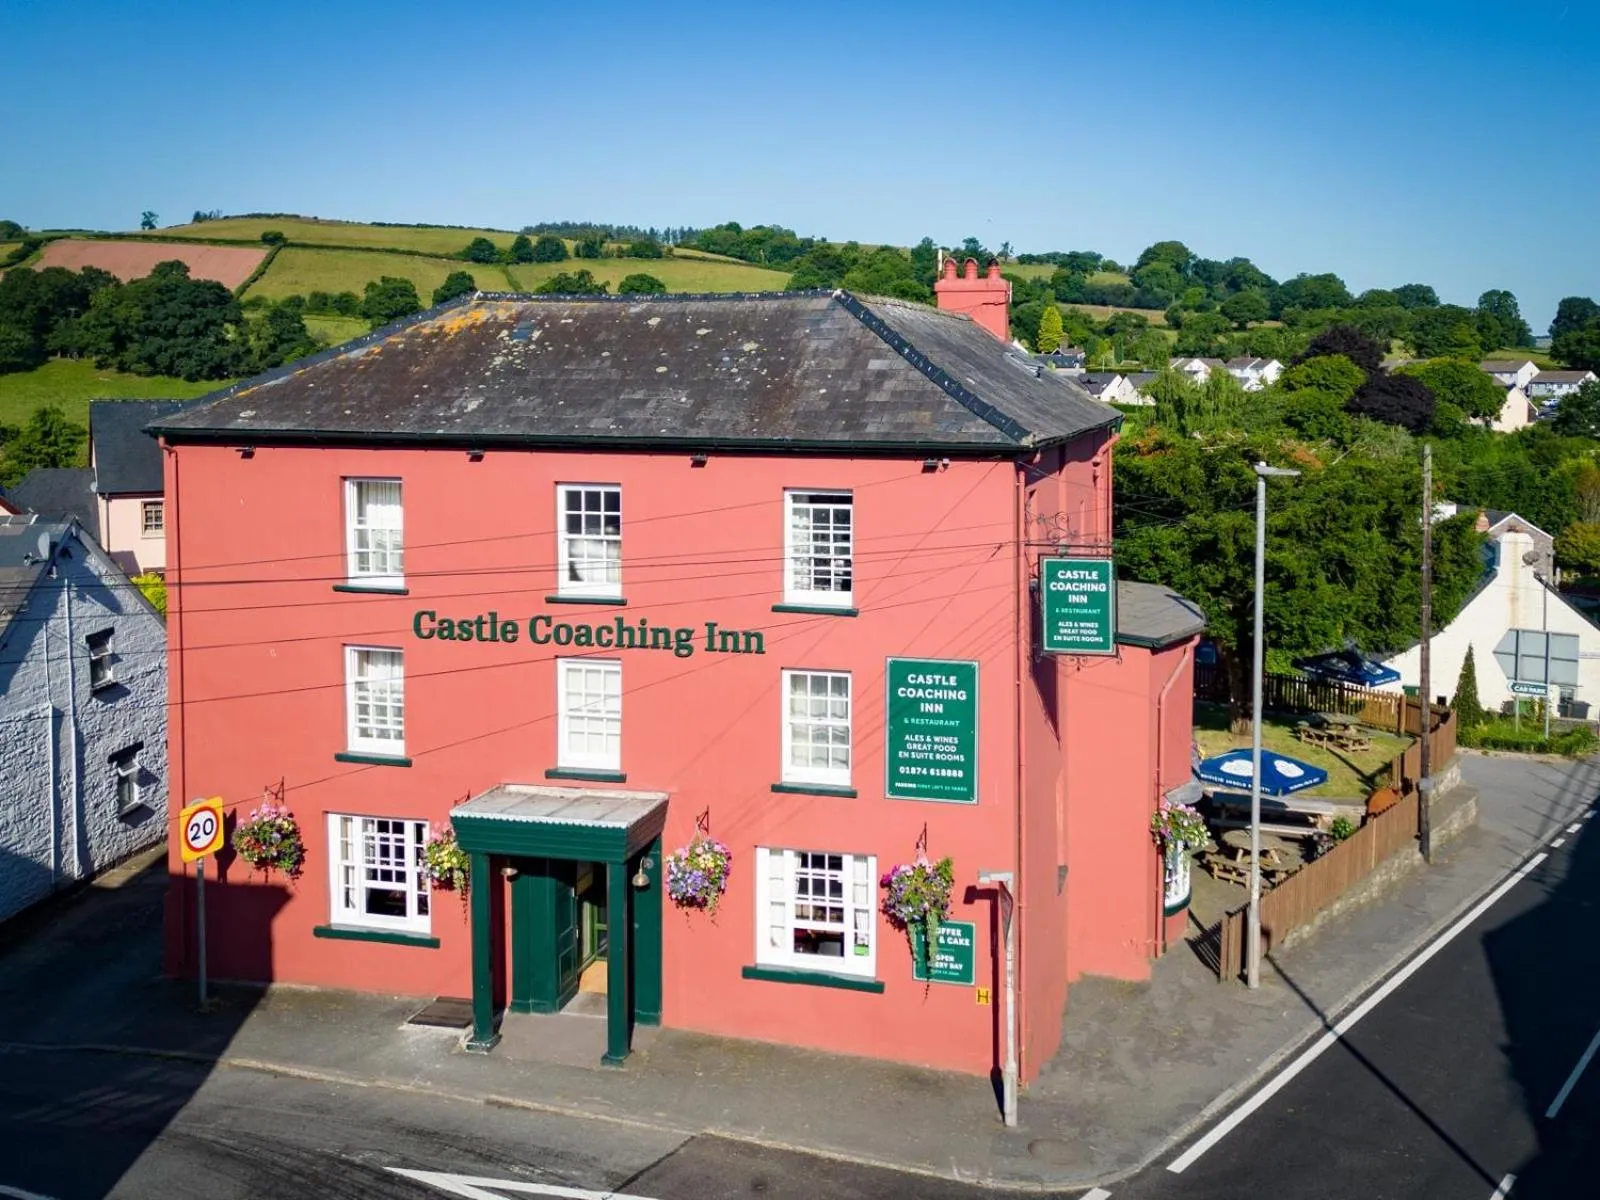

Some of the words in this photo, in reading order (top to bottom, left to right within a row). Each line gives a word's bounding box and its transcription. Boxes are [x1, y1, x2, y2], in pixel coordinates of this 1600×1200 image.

[1057, 570, 1099, 580] CASTLE
[1049, 581, 1107, 592] COACHING
[1068, 594, 1088, 603] INN
[413, 610, 520, 643] Castle
[528, 613, 695, 658] Coaching
[705, 621, 766, 655] Inn
[907, 673, 958, 686] CASTLE
[897, 687, 967, 700] COACHING
[920, 702, 944, 713] INN
[910, 718, 960, 726] RESTAURANT
[904, 734, 925, 742] ALES
[933, 736, 959, 744] WINES
[906, 743, 931, 751] GREAT
[933, 744, 957, 752] FOOD
[910, 751, 934, 760] SUITE
[935, 753, 965, 762] ROOMS
[899, 766, 928, 775] 01874
[190, 817, 214, 842] 20
[938, 935, 946, 944] &
[946, 937, 971, 946] CAKE
[935, 954, 955, 962] OPEN
[949, 962, 963, 970] DAY
[977, 989, 989, 1004] H
